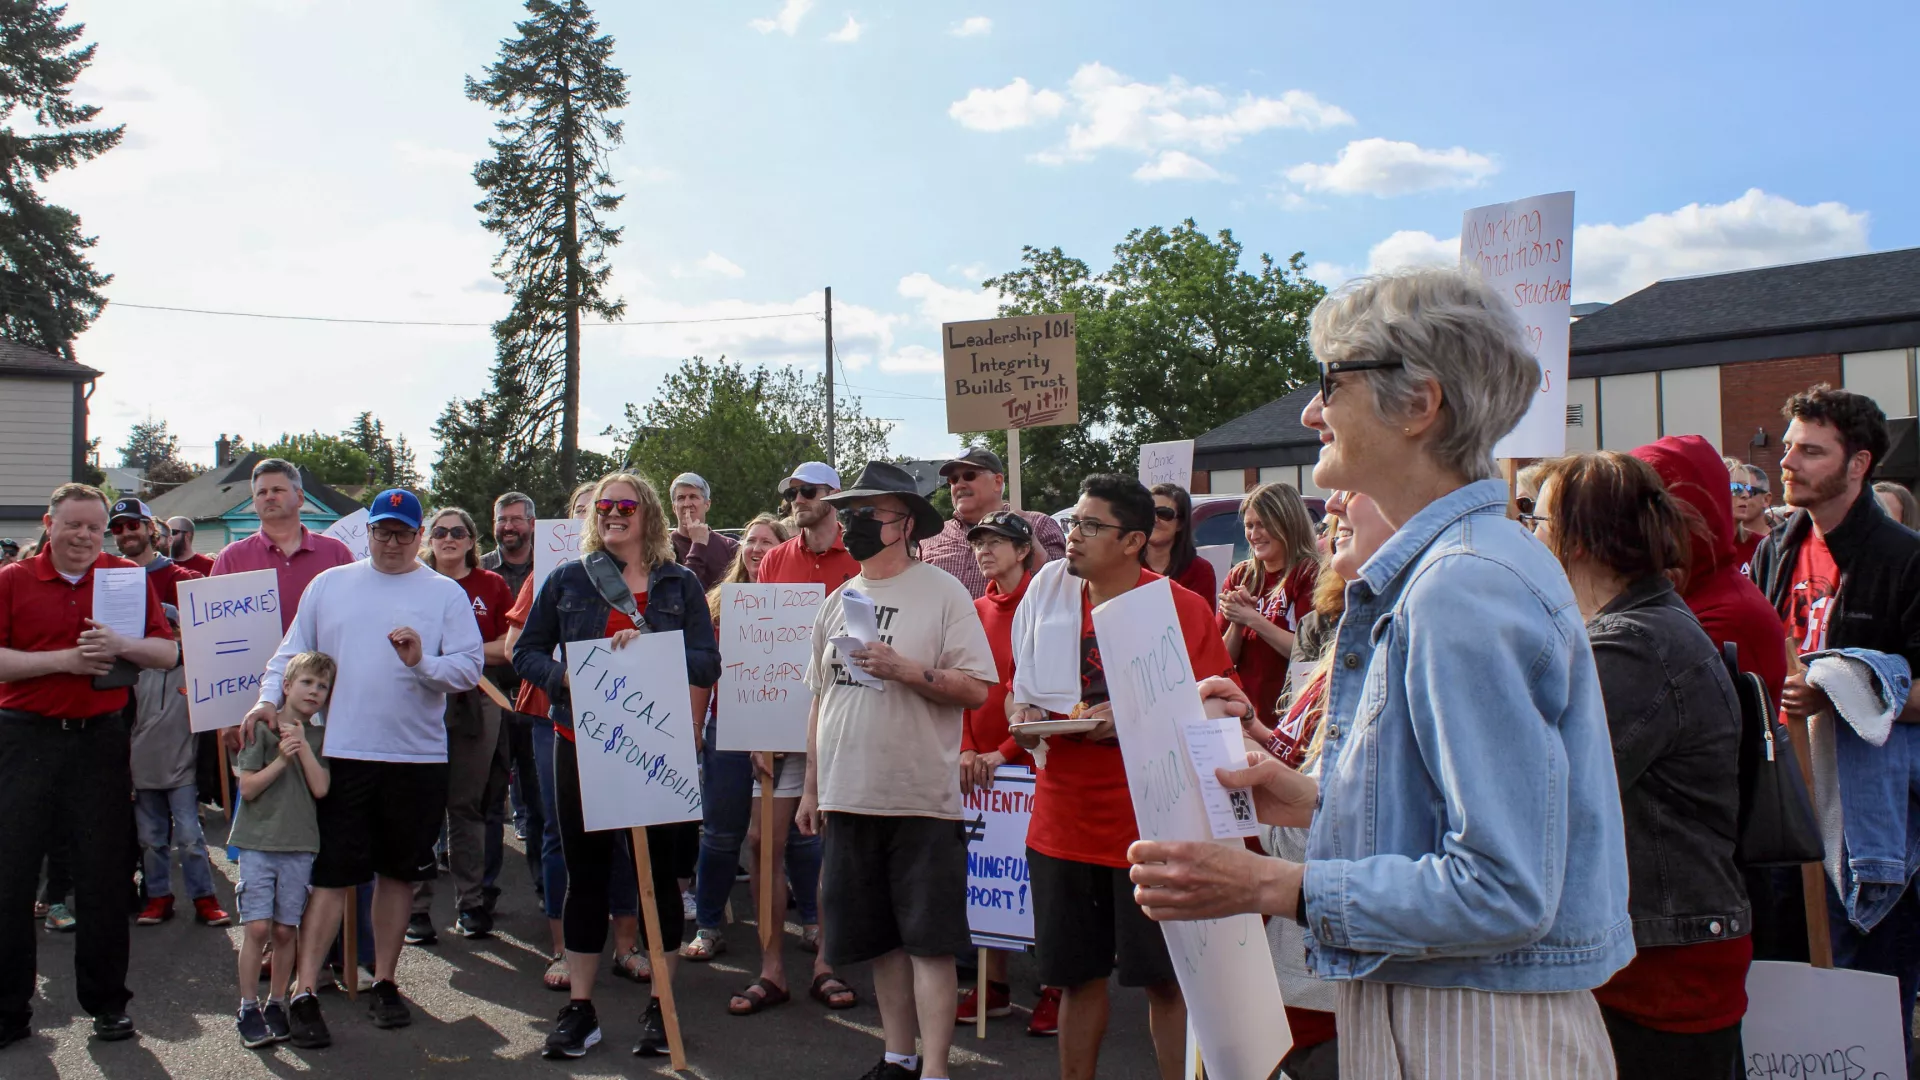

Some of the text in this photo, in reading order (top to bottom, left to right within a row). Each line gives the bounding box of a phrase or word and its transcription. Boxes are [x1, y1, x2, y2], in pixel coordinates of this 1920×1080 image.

[1468, 210, 1542, 249] Working
[948, 319, 1074, 348] Leadership 101:
[970, 352, 1050, 376] Integrity
[955, 373, 1066, 395] Builds Trust
[1002, 397, 1033, 422] Try
[1147, 450, 1176, 469] Come
[189, 589, 278, 627] LIBRARIES
[734, 587, 820, 616] April 2022
[740, 624, 774, 655] May
[726, 662, 803, 683] The GAPS
[194, 672, 266, 704] LITERAC
